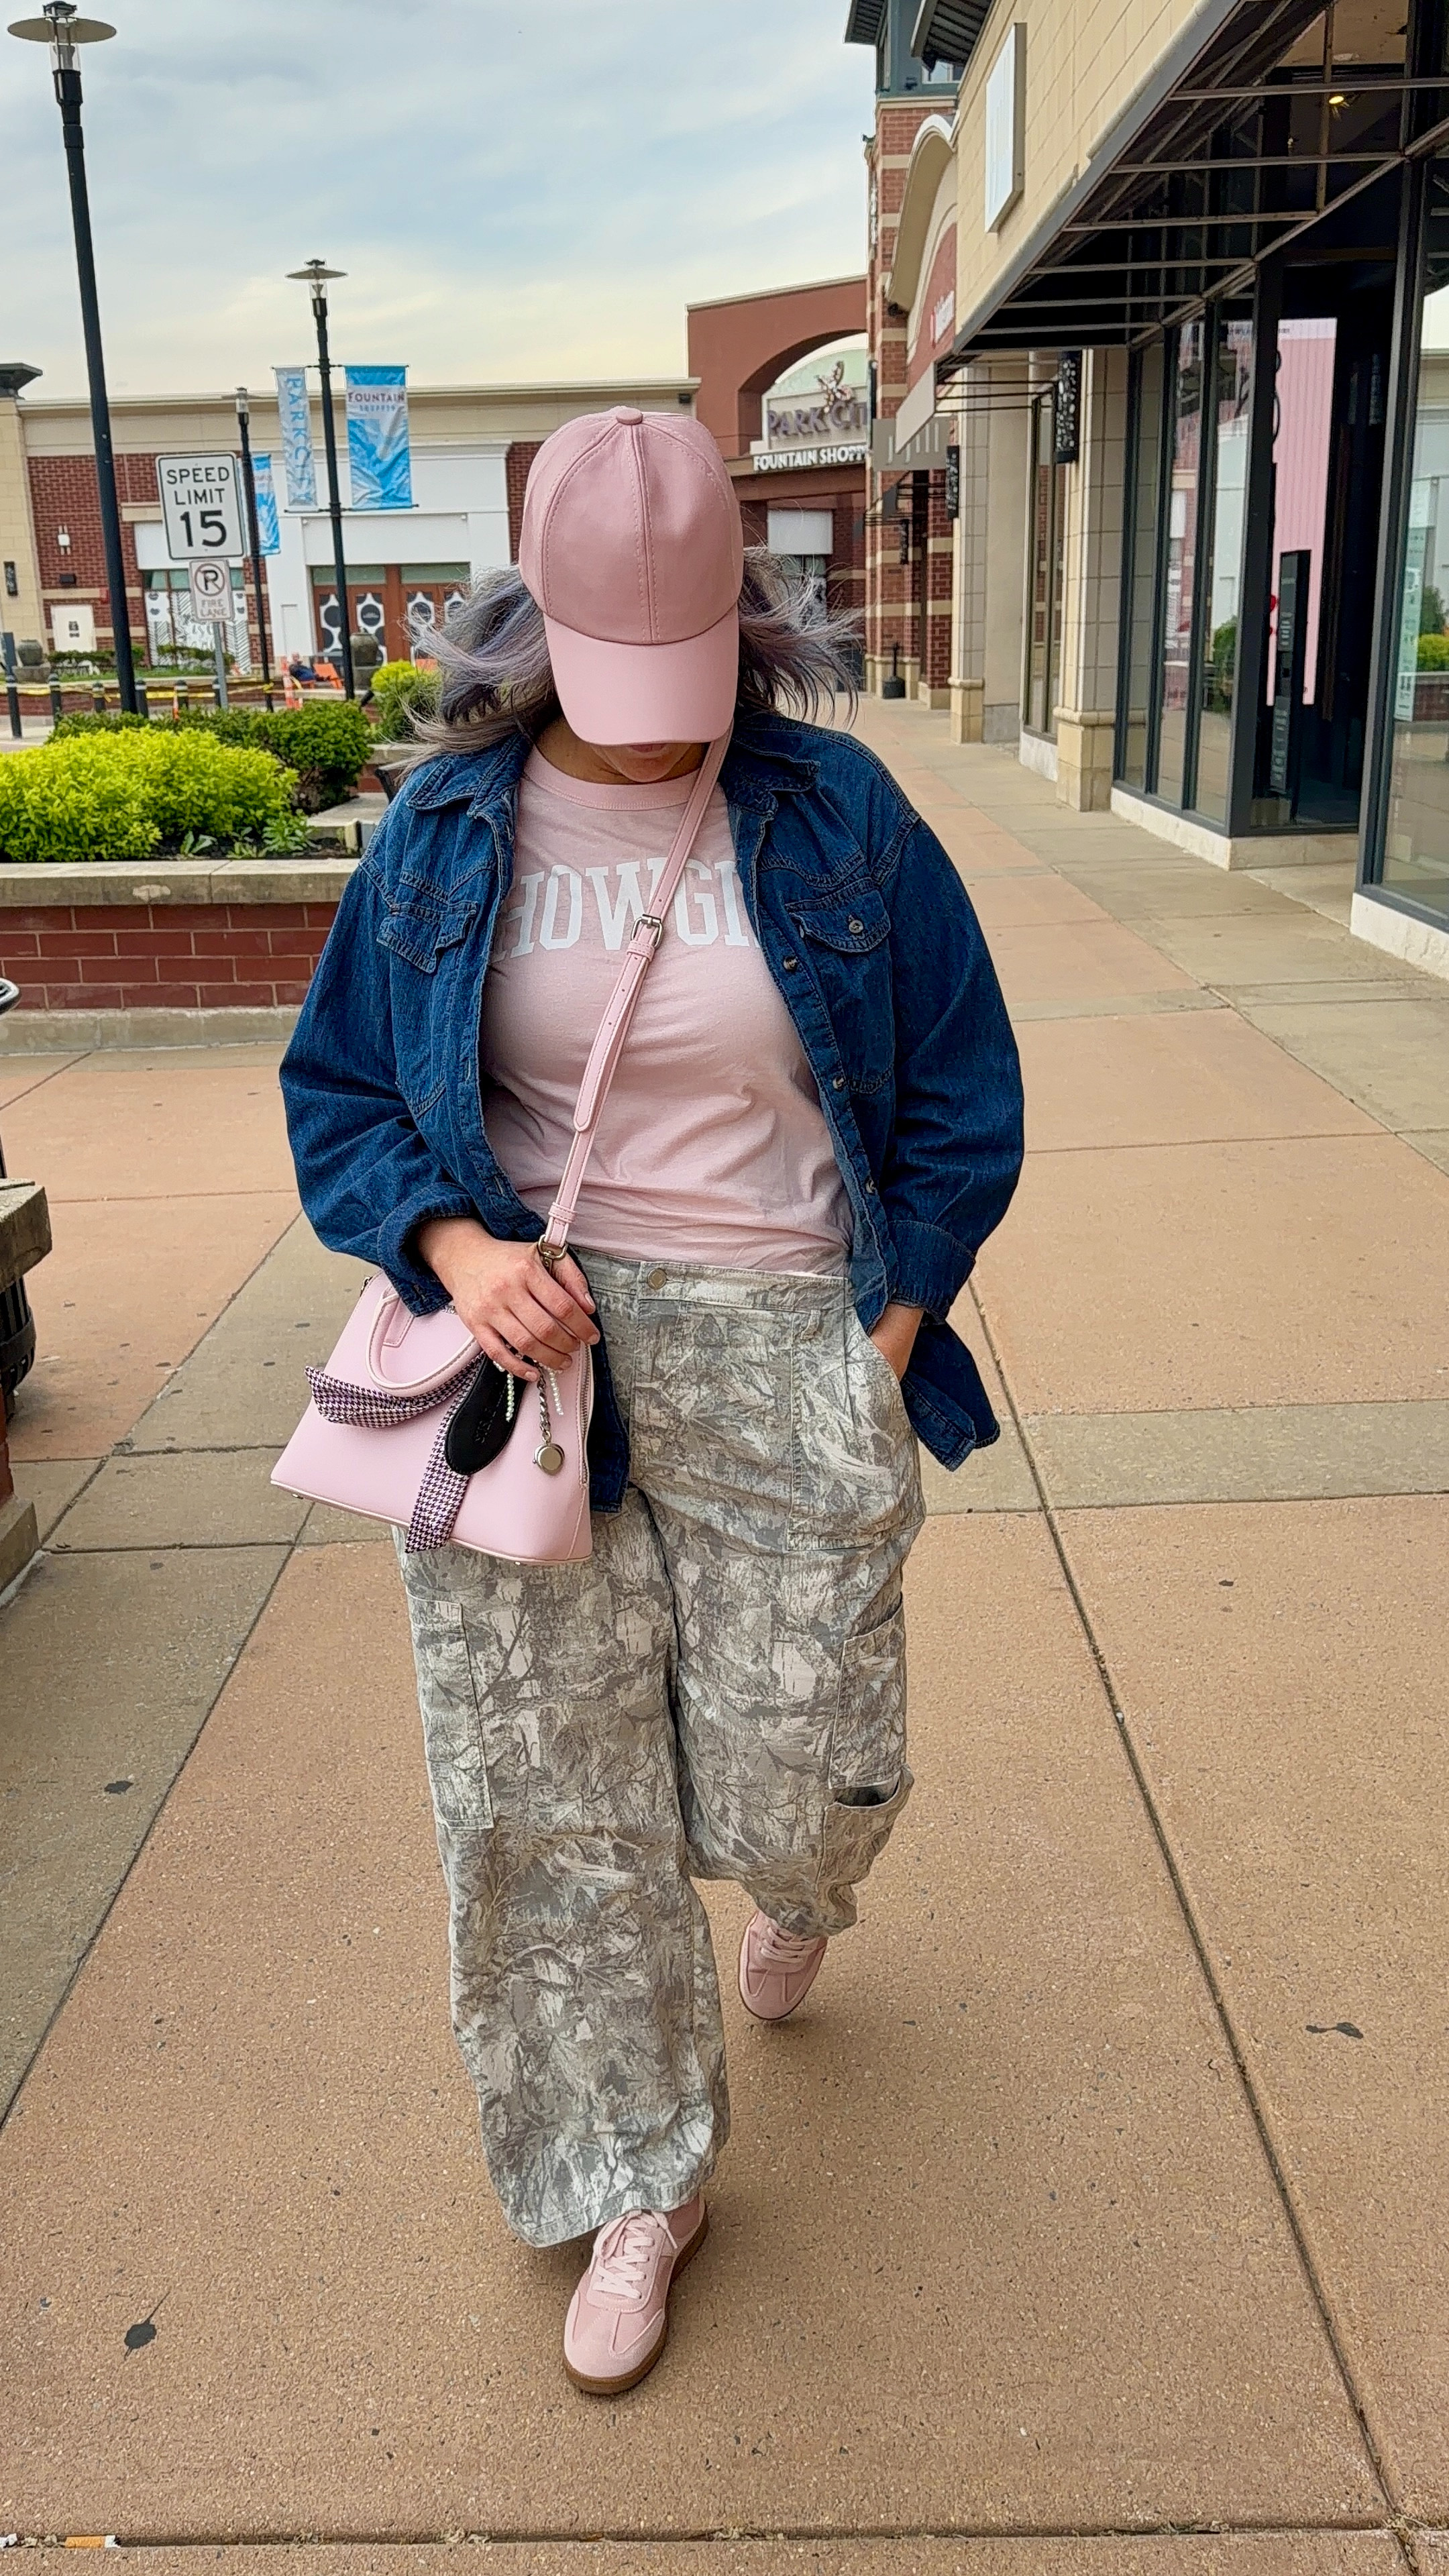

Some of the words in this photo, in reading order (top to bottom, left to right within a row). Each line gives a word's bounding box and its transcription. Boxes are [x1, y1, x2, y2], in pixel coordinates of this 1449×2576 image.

[347, 391, 405, 402] FOUNTAIN
[767, 407, 829, 437] PARK
[753, 450, 818, 471] FOUNTAIN
[166, 466, 229, 484] SPEED
[174, 488, 225, 505] LIMIT
[180, 510, 227, 547] 15
[201, 598, 223, 607] FIRE
[493, 857, 761, 962] HOWGI
